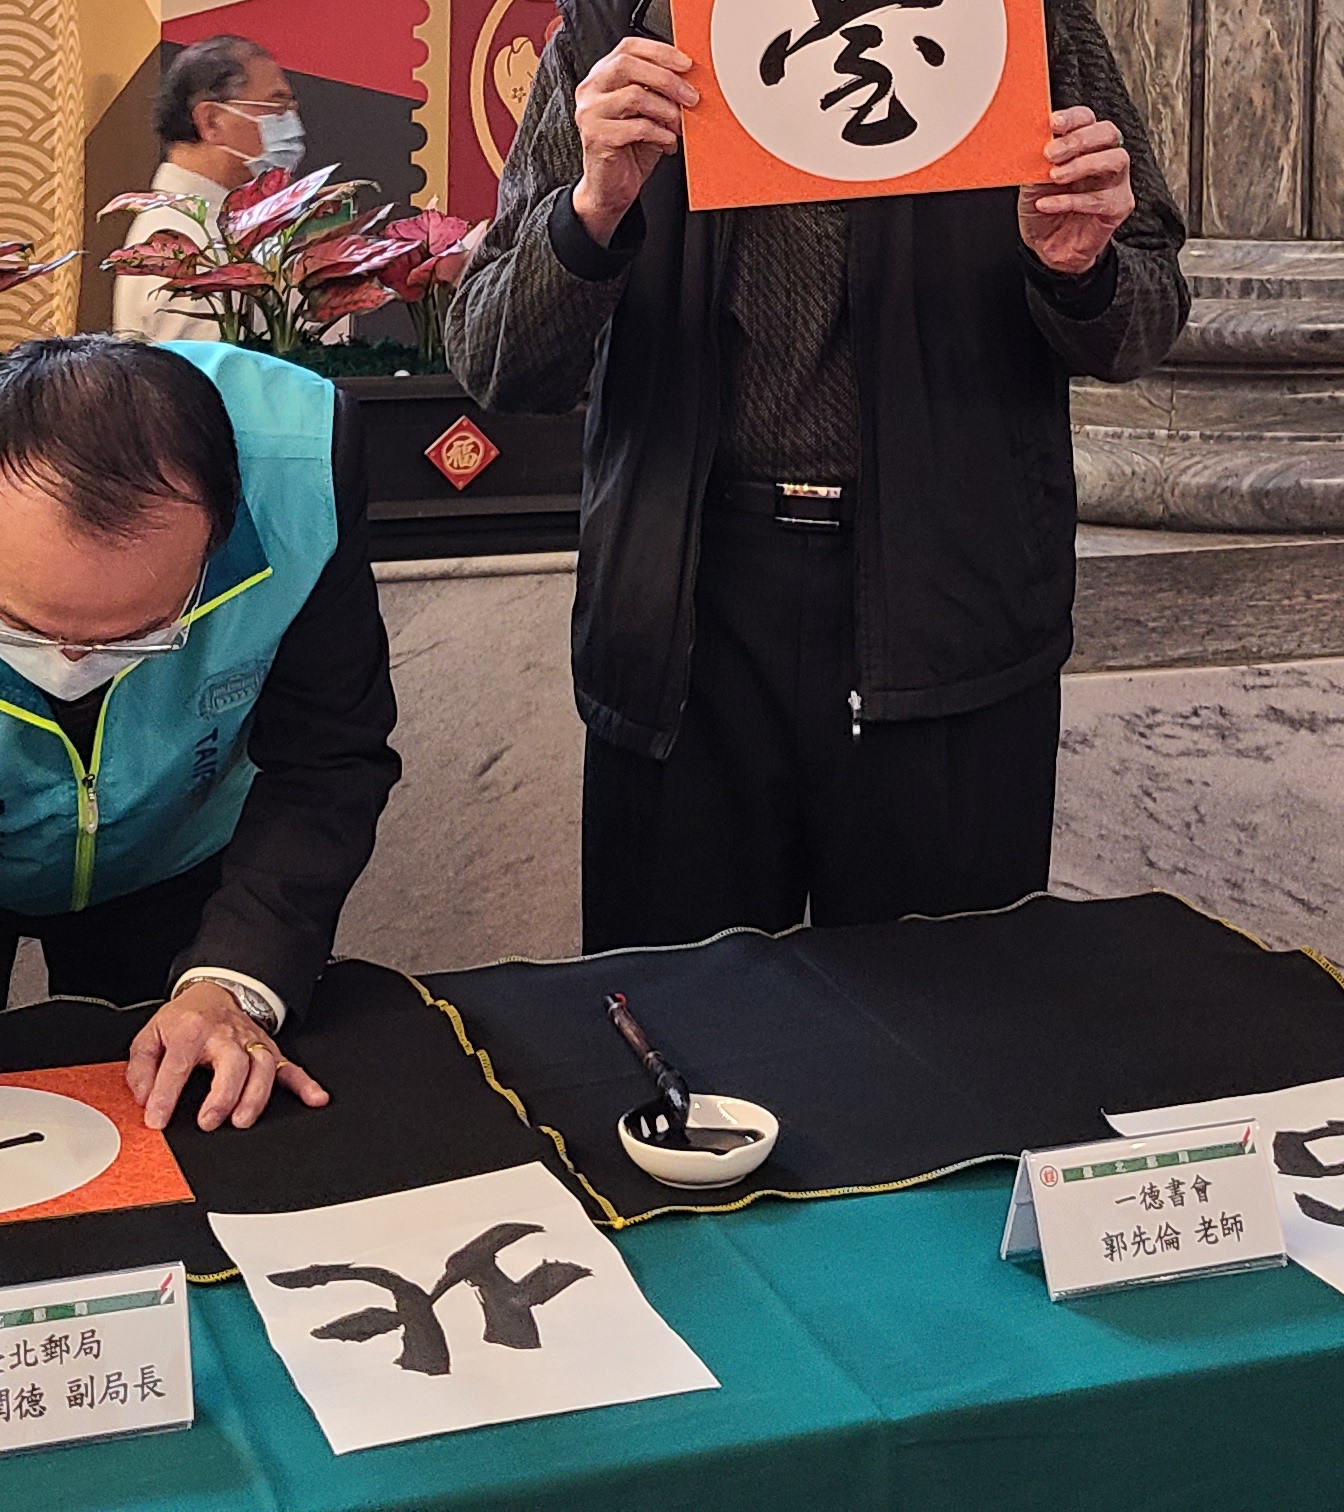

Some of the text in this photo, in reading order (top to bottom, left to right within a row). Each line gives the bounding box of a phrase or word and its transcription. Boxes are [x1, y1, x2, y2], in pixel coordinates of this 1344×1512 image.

[446, 438, 478, 468] 福
[1101, 1211, 1244, 1262] 郭先倫 老師
[66, 1364, 167, 1409] 副局長
